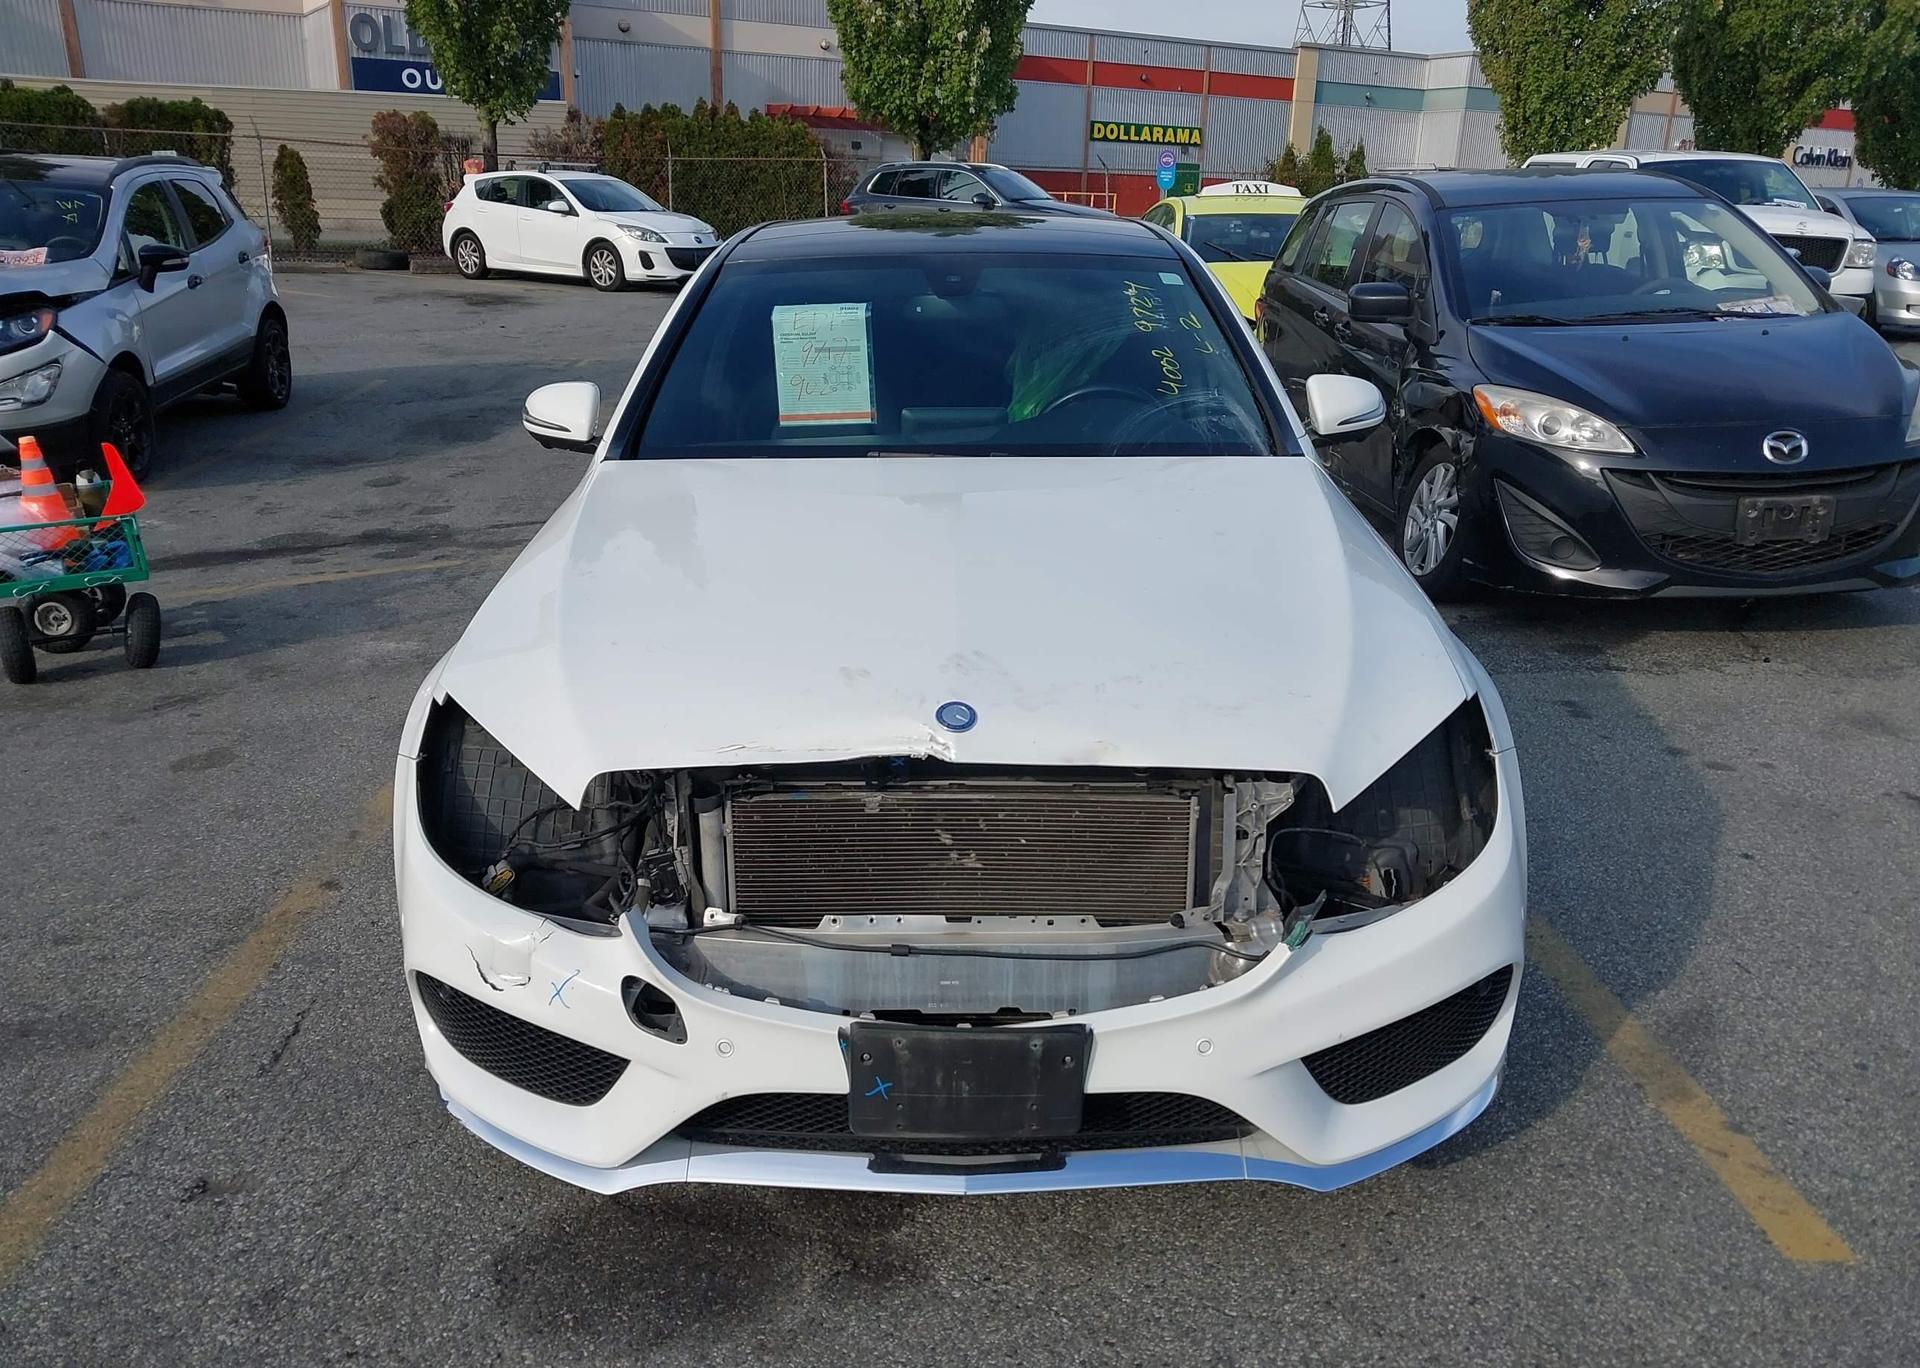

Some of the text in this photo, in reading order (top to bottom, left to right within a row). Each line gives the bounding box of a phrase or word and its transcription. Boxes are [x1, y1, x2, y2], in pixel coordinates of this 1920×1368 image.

[1093, 122, 1201, 145] DOLLARAMA
[1793, 145, 1851, 168] Calvin Klein
[1232, 183, 1270, 194] TAXI
